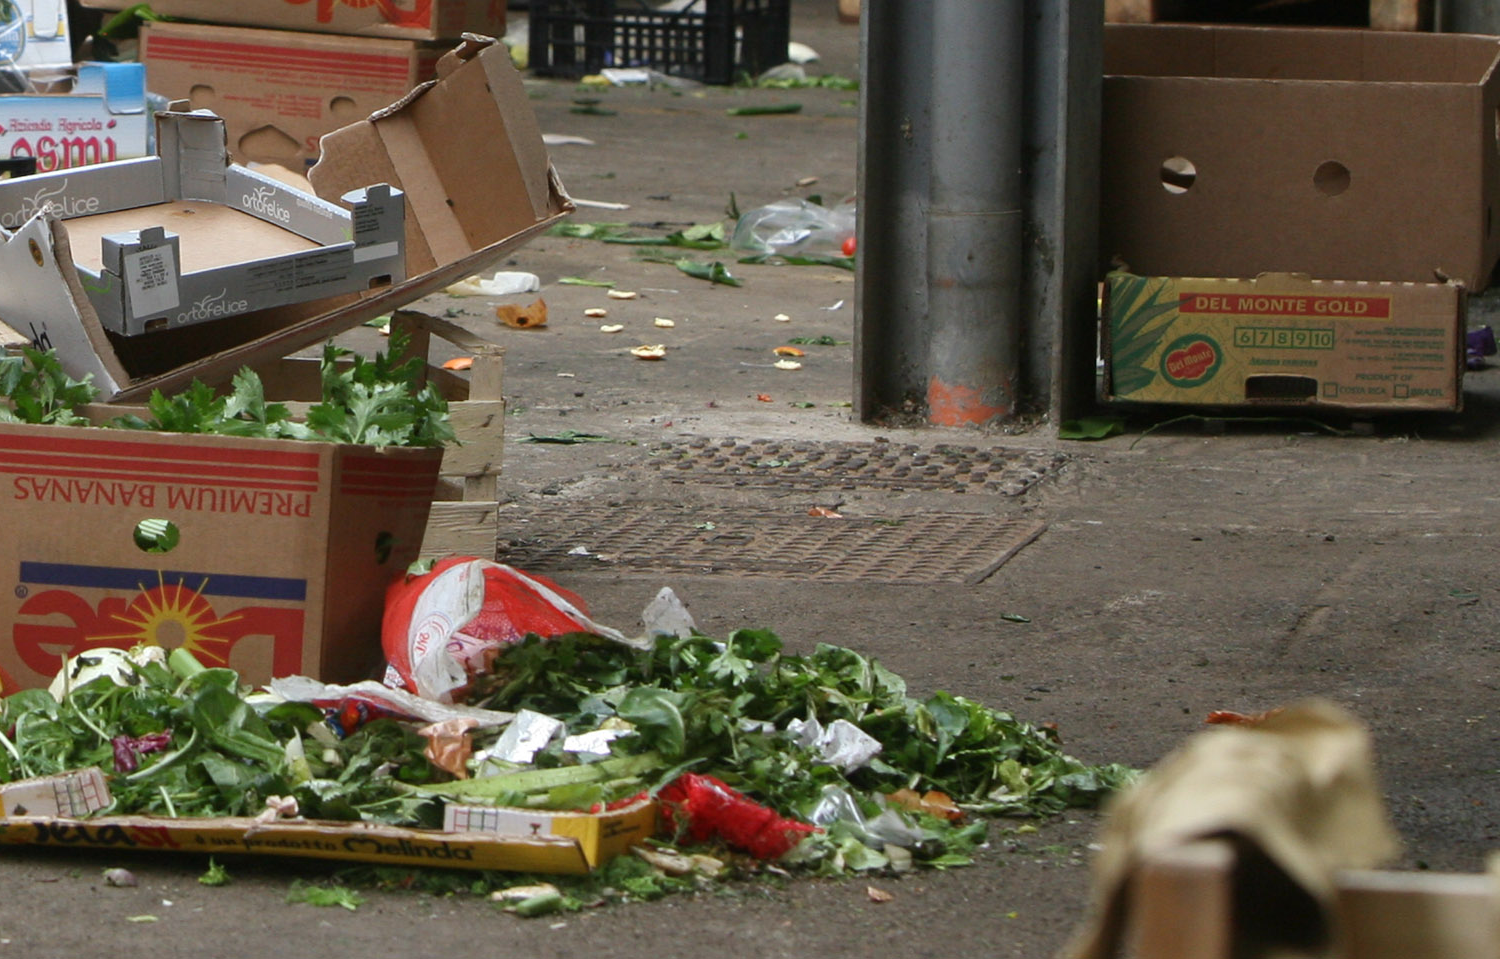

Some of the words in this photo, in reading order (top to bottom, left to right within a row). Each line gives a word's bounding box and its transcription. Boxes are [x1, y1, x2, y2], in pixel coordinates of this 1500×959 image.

[9, 118, 52, 132] Azienda
[58, 118, 103, 135] Agricola
[177, 297, 248, 324] ortofelice
[1195, 296, 1232, 310] DEL
[1238, 298, 1307, 312] MONTE
[1313, 299, 1368, 314] GOLD
[1240, 331, 1250, 343] 6
[1260, 331, 1269, 343] 7
[1278, 332, 1287, 343] 8
[1298, 332, 1307, 344] 9
[1314, 332, 1331, 345] 10
[13, 476, 156, 508] BANANAS
[167, 486, 312, 518] PREMIUM
[343, 834, 472, 861] Melinda
